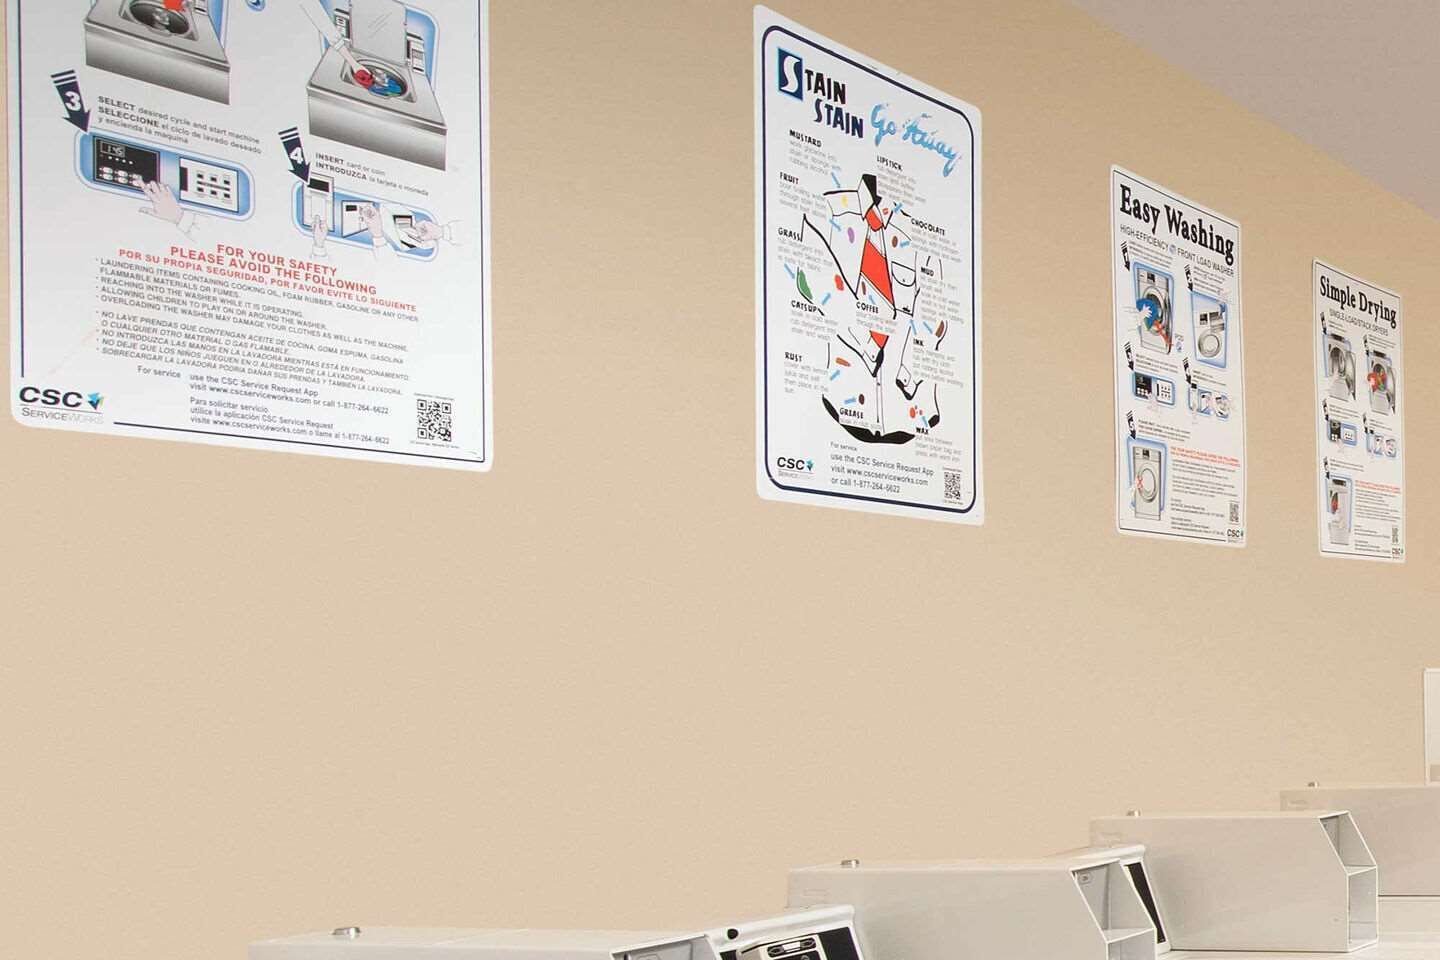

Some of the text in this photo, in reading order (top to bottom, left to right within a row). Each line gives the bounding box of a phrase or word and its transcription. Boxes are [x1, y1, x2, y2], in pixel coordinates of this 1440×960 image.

[780, 55, 846, 104] STAIN
[64, 91, 81, 112] 3
[98, 95, 136, 113] SELECT
[98, 105, 159, 129] SELECCIONE
[814, 99, 863, 139] STAIN
[789, 130, 822, 148] MUSTARD
[871, 104, 960, 177] Go Away
[289, 146, 303, 164] 4
[316, 153, 343, 166] INSERT
[877, 155, 903, 171] LIPSTICK
[316, 162, 366, 180] INTRODUZCA
[780, 172, 799, 185] FRUIT
[911, 218, 945, 236] CHOCOLATE
[1120, 184, 1160, 235] Easy
[1164, 205, 1234, 266] Washing
[778, 227, 800, 242] GRASS
[217, 244, 337, 277] FOR YOUR SAFETY
[171, 246, 376, 295] PLEASE AVOID THE FOLLOWING
[920, 266, 934, 277] MUD
[119, 248, 416, 312] POR SU PROPIA SEGURIDAD, POR FAVOR EVITE LO SIGUIENTE
[791, 300, 818, 313] CATSUP
[856, 301, 879, 314] COFFEE
[1320, 276, 1356, 310] Simple
[1358, 291, 1396, 329] Drying
[913, 338, 924, 346] INK
[785, 352, 802, 362] RUST
[137, 366, 180, 379] For service
[190, 383, 207, 391] visit
[209, 385, 311, 405] www.cscserviceworks.com
[324, 400, 335, 408] call
[206, 375, 219, 384] the
[221, 377, 238, 386] CSC
[241, 380, 269, 390] Service
[271, 384, 302, 397] Request
[304, 389, 318, 399] App
[19, 385, 83, 409] CSC
[840, 408, 864, 419] GREASE
[916, 426, 929, 435] WAX
[776, 456, 805, 471] CSC
[831, 453, 842, 461] use
[844, 454, 854, 462] the
[856, 456, 871, 466] CSC
[872, 458, 894, 469] Service
[896, 462, 922, 474] Request
[925, 466, 934, 476] App
[831, 466, 845, 474] visit
[839, 478, 851, 486] call
